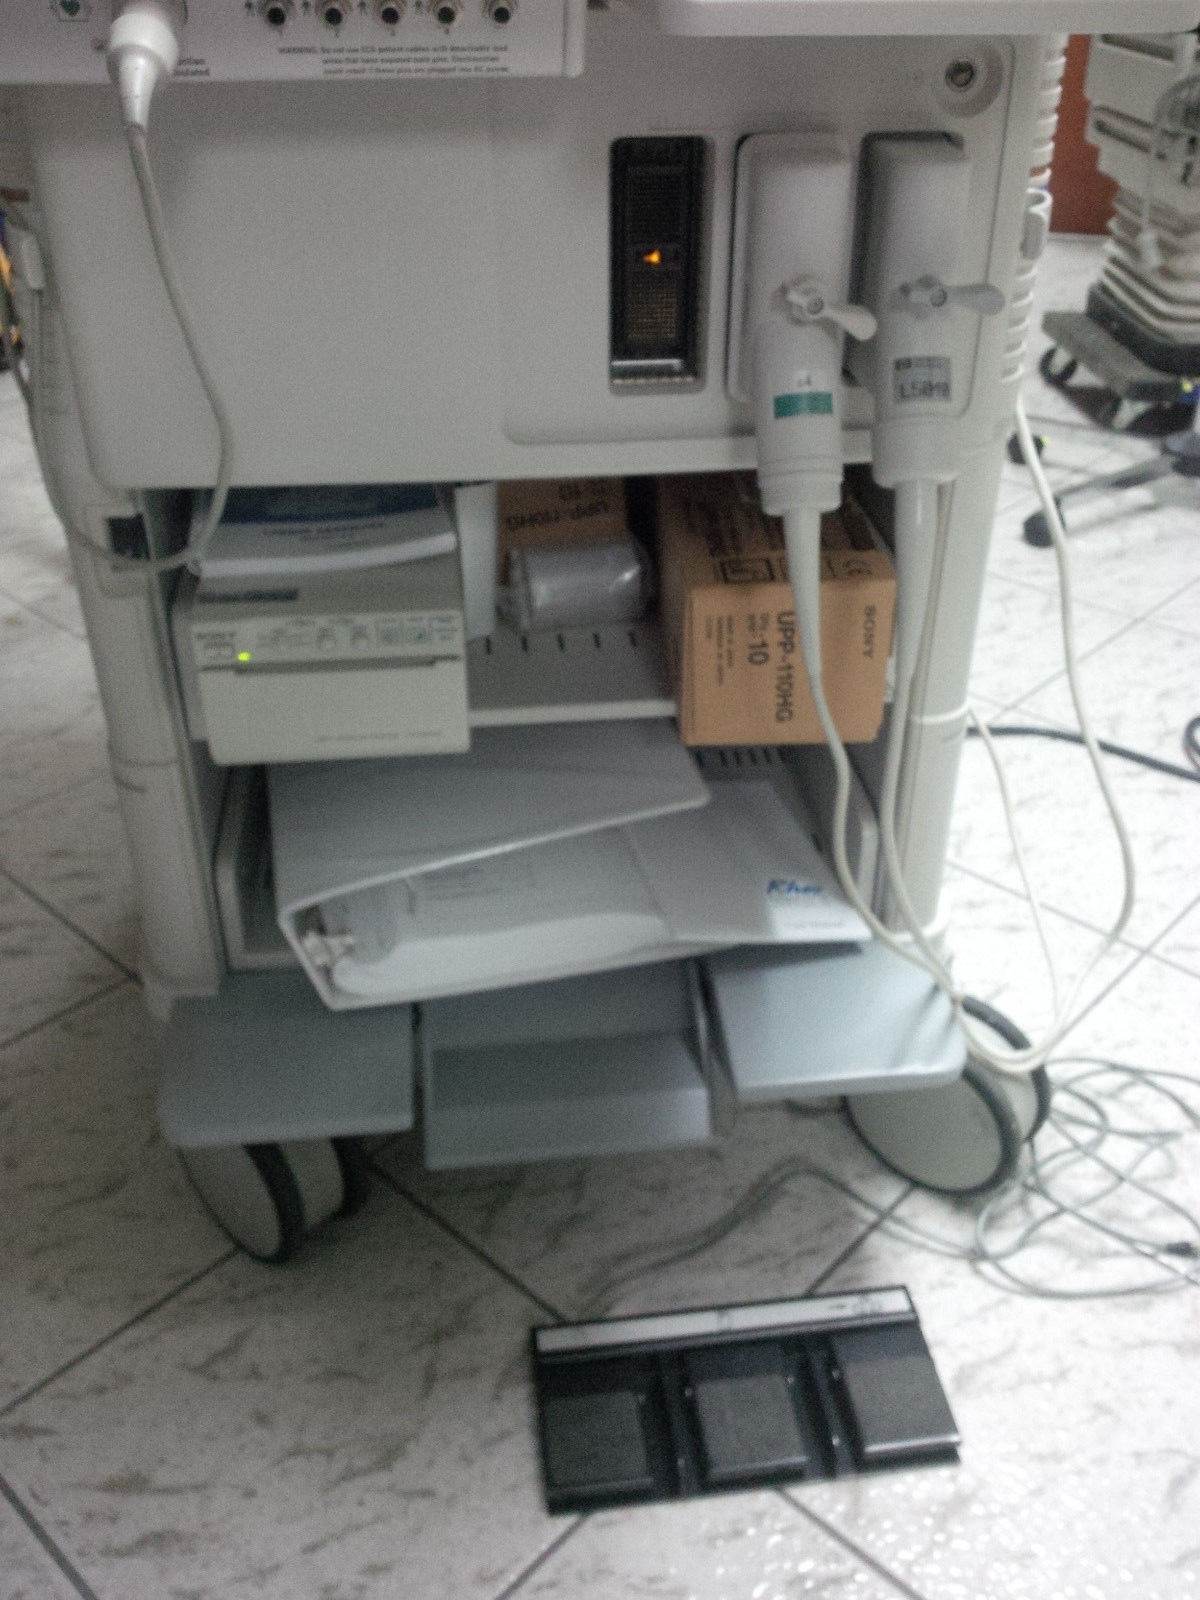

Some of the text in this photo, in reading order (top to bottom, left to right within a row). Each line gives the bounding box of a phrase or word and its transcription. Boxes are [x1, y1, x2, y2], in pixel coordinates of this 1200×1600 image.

[747, 640, 770, 667] 10
[864, 606, 876, 658] SONY
[775, 610, 796, 724] UPP-110HG
